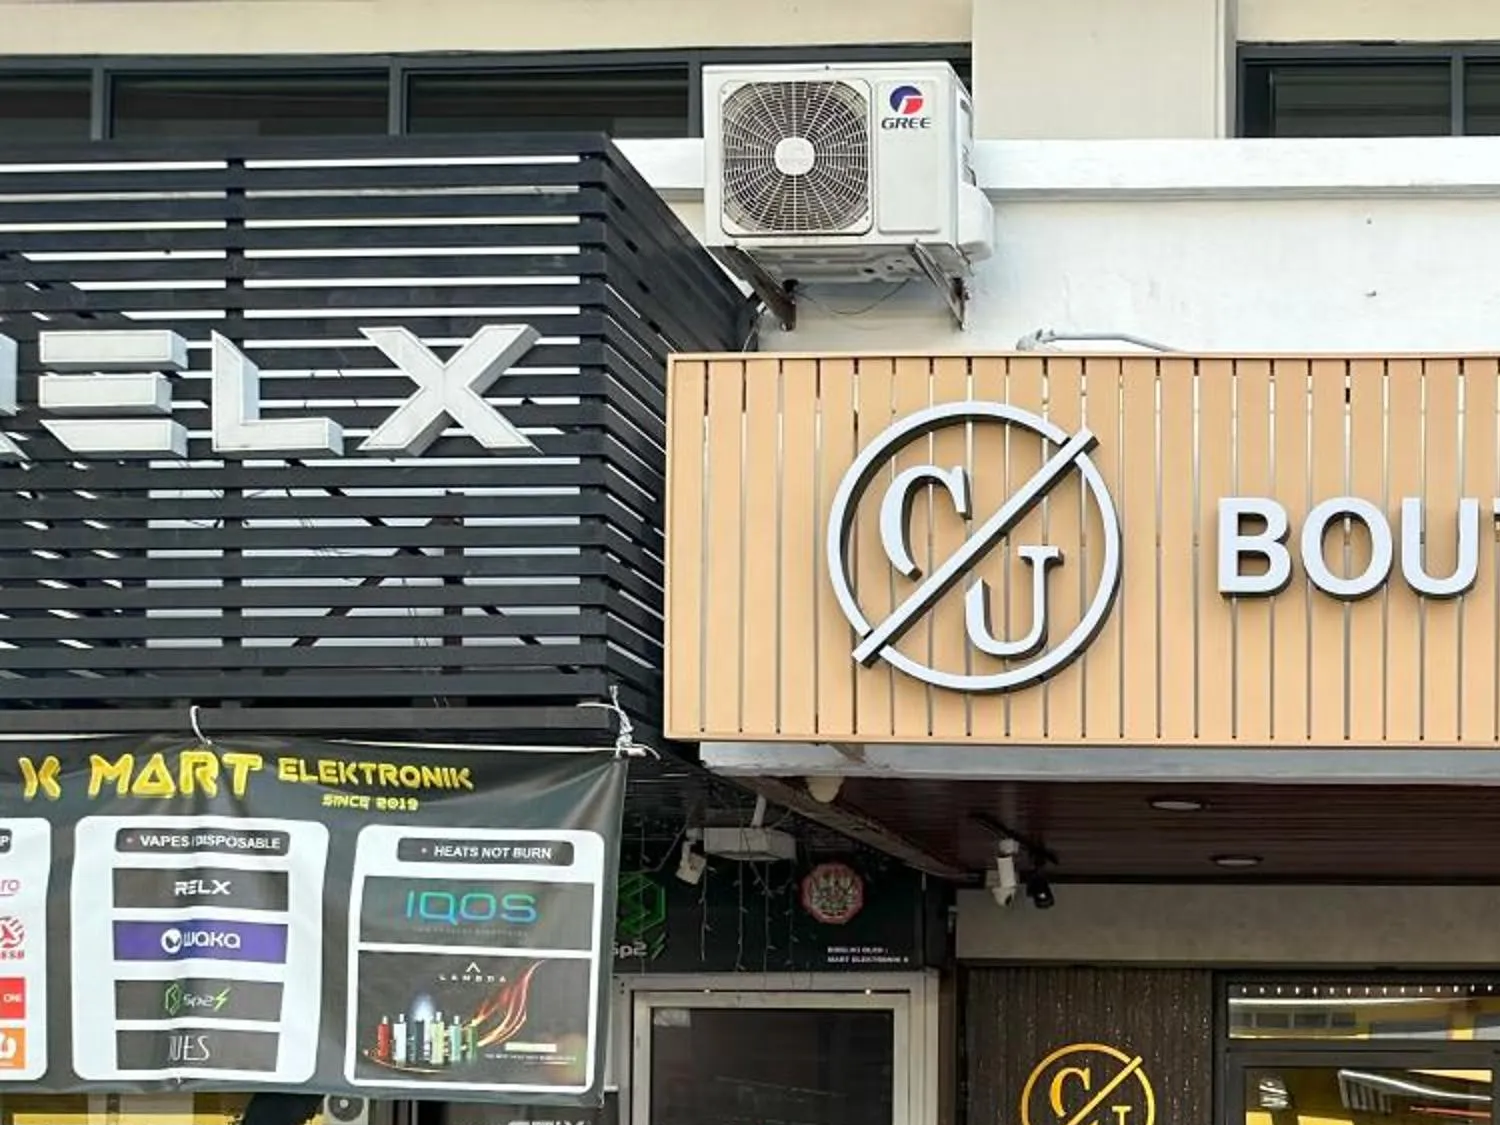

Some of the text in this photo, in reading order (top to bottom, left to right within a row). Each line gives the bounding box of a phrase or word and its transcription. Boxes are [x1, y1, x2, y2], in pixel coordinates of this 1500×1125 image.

[881, 117, 931, 129] GREE
[0, 324, 543, 458] ELX
[88, 750, 263, 800] MART
[277, 757, 475, 791] ELEKTRONIK
[321, 793, 370, 810] SINCE
[139, 835, 190, 848] VAPES
[433, 845, 553, 860] HEATS NOT BURN
[174, 880, 231, 897] RELX
[406, 889, 538, 925] IQOS
